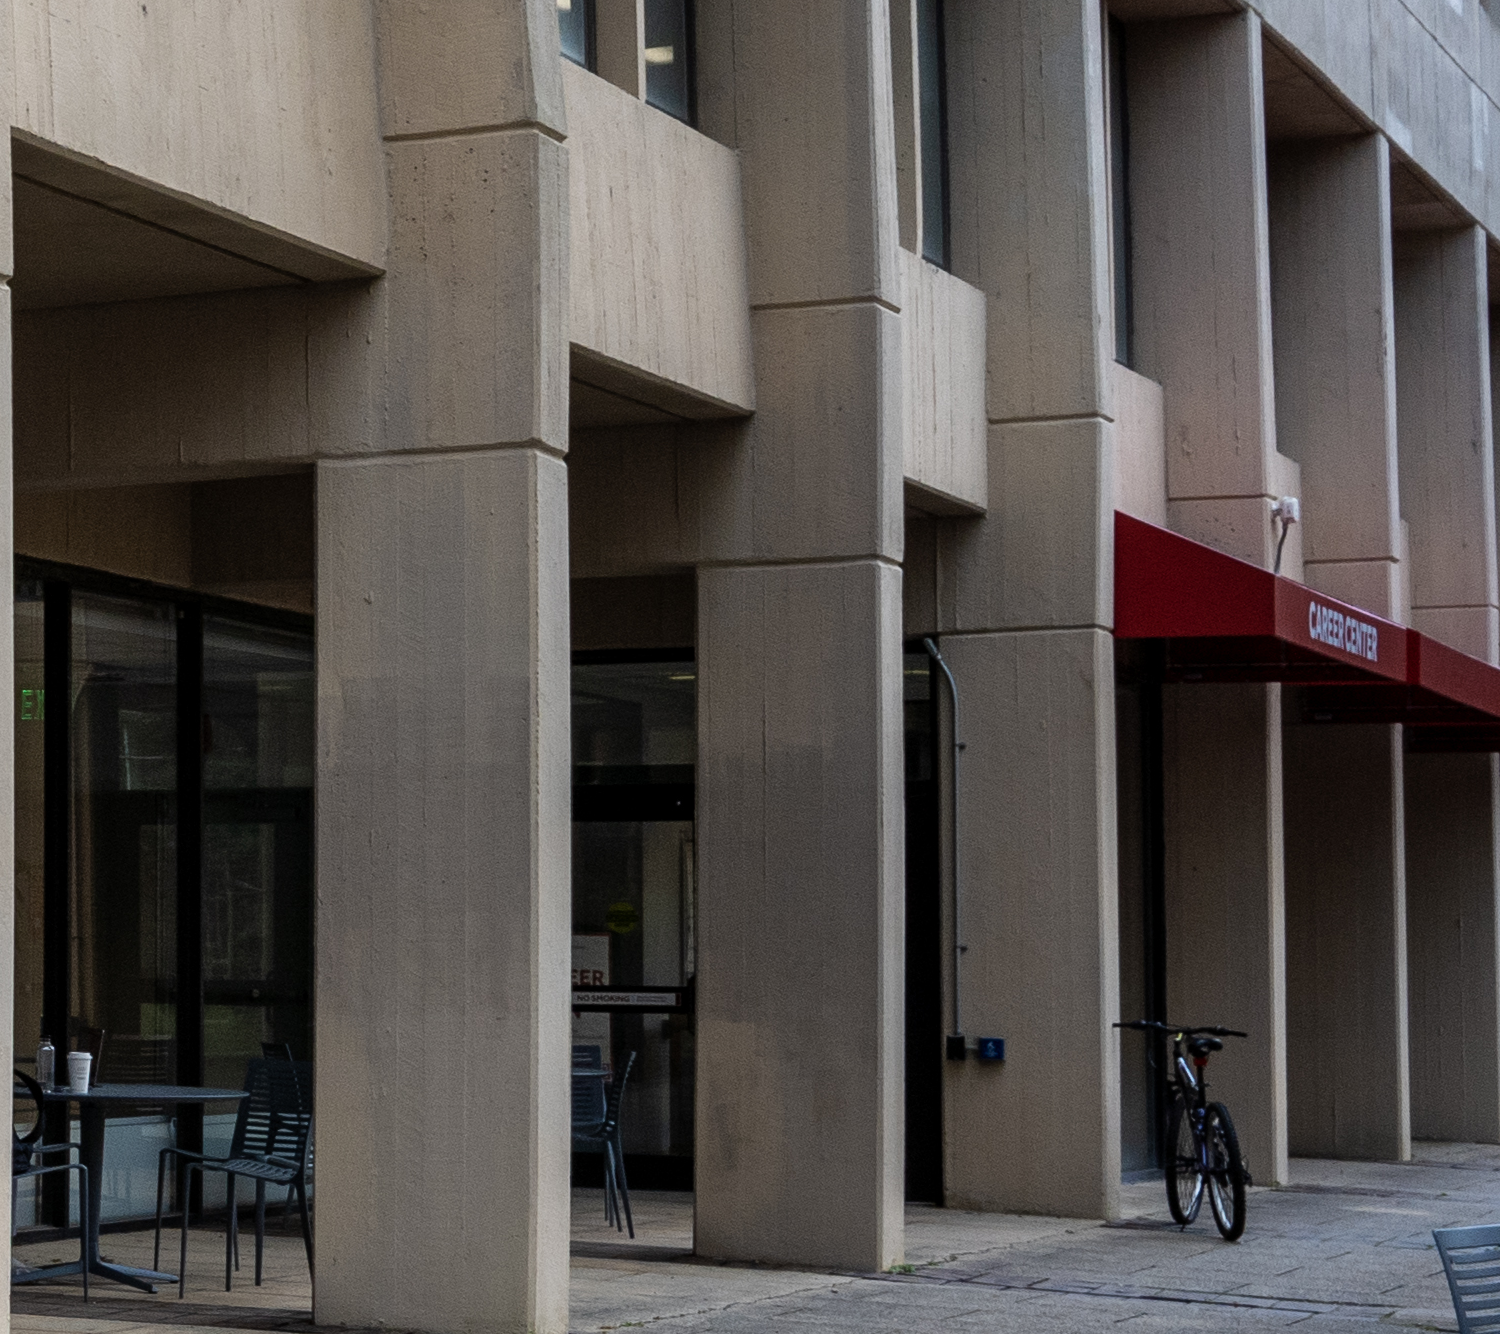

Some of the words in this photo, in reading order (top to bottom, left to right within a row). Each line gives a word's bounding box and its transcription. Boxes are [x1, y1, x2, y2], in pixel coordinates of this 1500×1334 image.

[1308, 601, 1345, 650] CAREER
[1345, 615, 1378, 663] CENTER
[21, 689, 45, 720] EX
[576, 994, 590, 1002] NO
[591, 994, 630, 1003] SMOKING
